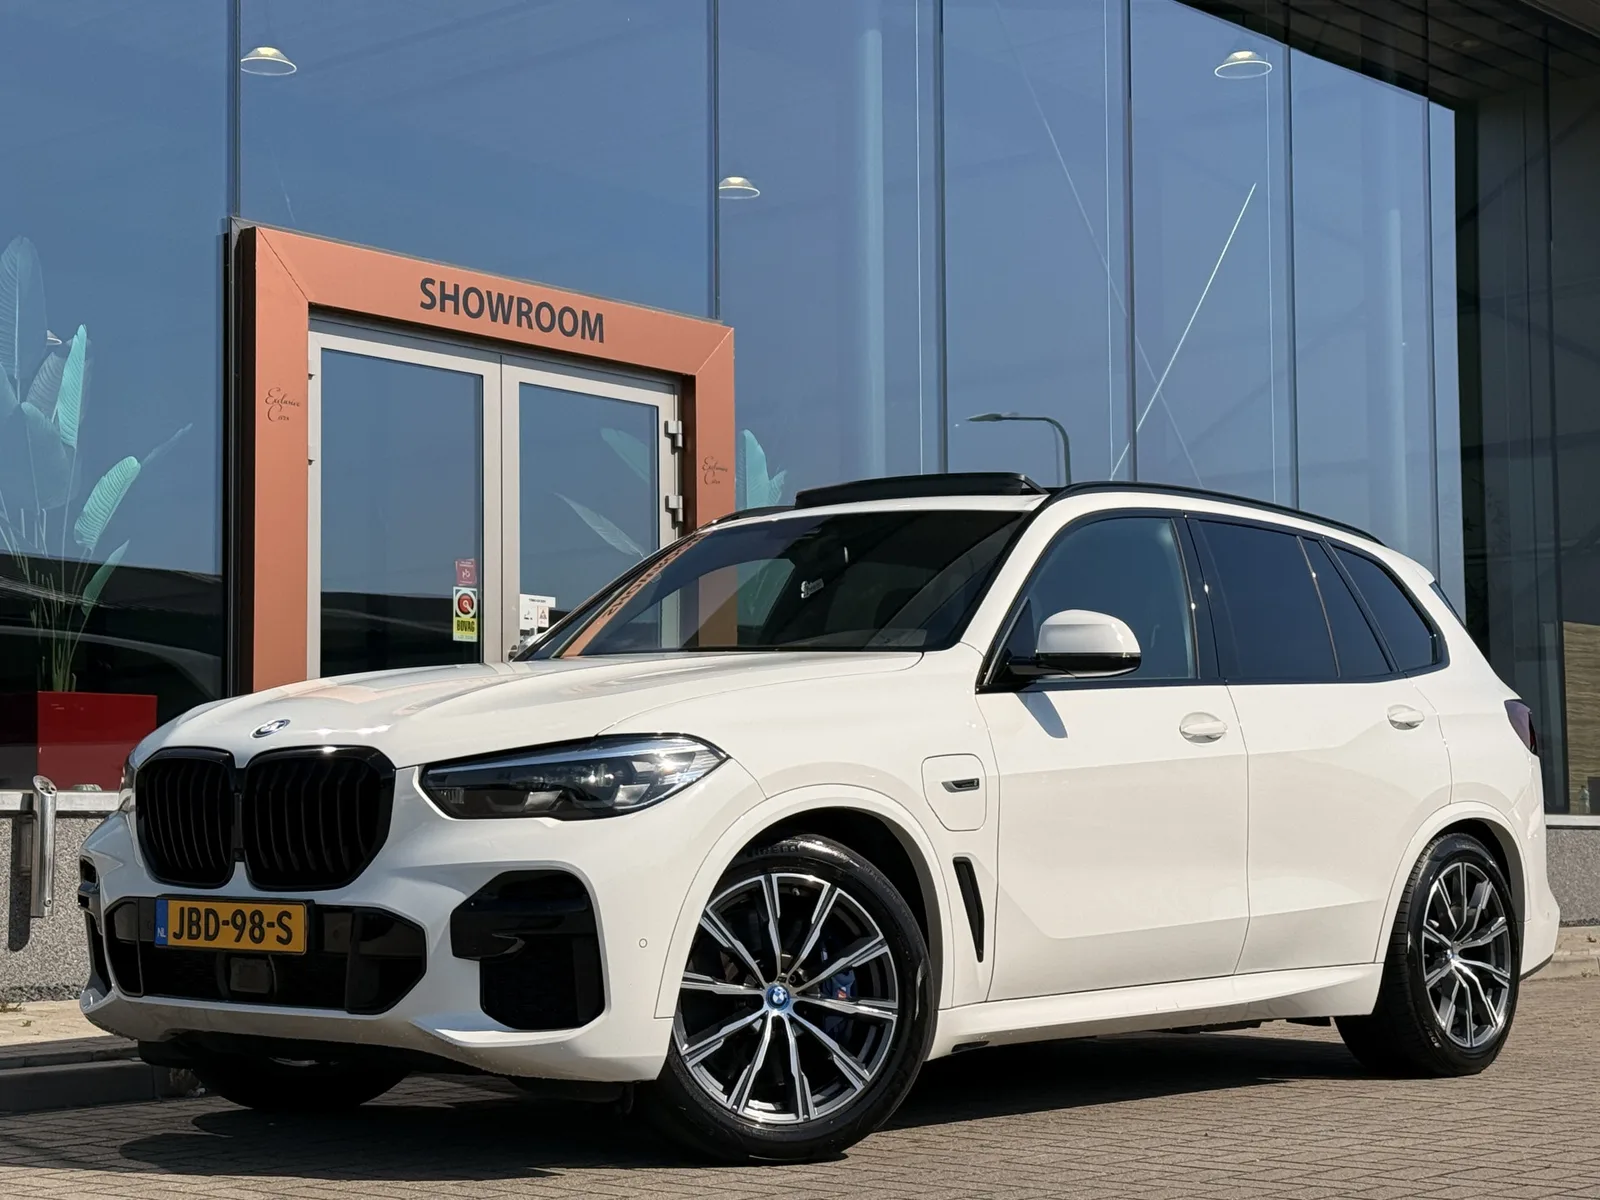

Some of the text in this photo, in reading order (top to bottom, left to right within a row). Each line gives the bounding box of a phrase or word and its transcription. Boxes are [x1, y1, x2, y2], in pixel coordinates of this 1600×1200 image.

[419, 276, 605, 344] SHOWROOM
[456, 620, 475, 632] BOVAG
[156, 906, 293, 946] NL JBD-98-S
